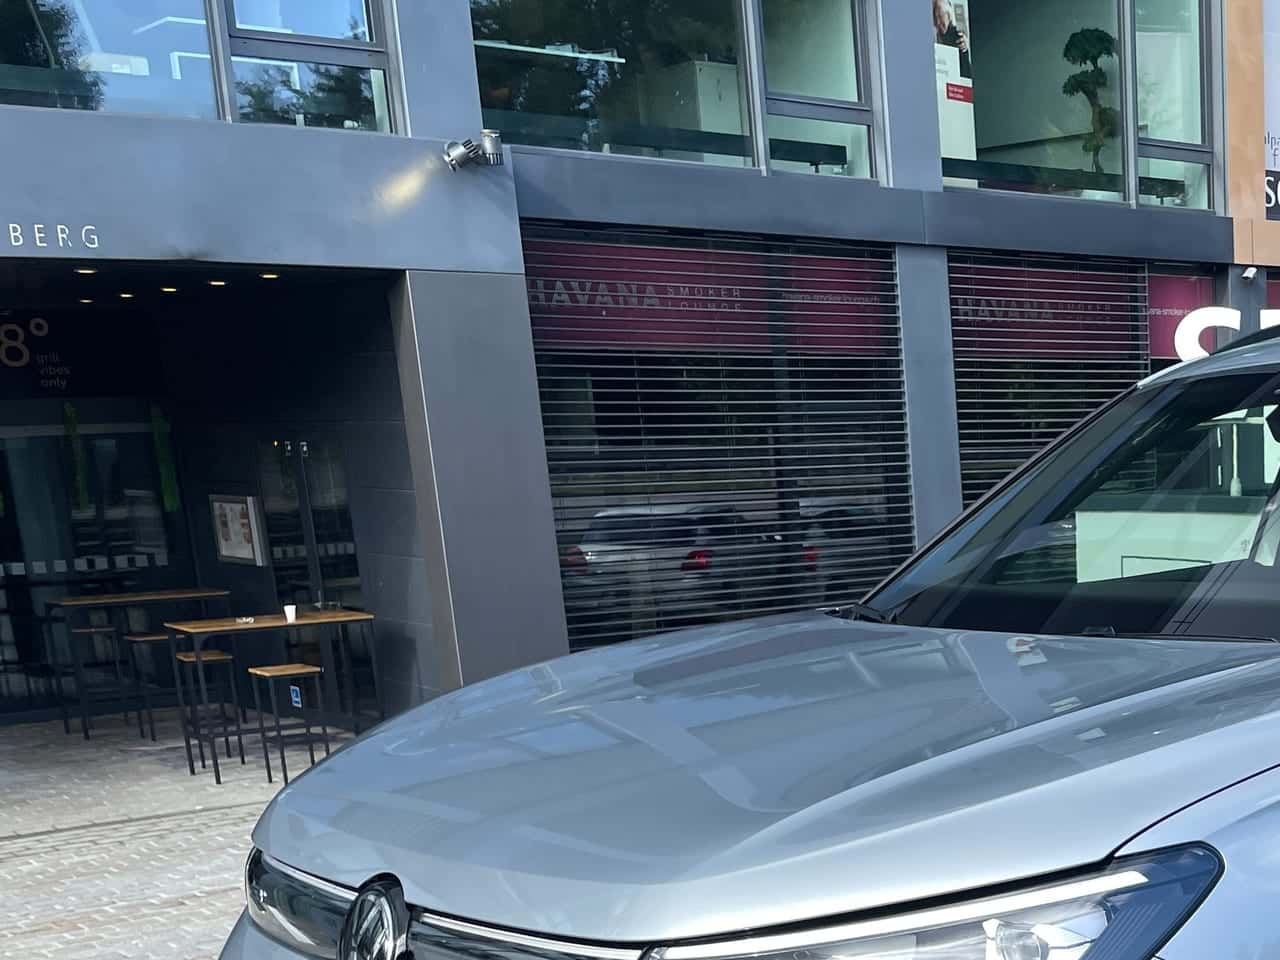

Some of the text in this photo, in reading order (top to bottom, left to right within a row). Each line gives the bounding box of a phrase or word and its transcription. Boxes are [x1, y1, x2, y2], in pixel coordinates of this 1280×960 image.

[8, 222, 100, 248] BERG
[528, 279, 743, 308] HAVANA SMOKER
